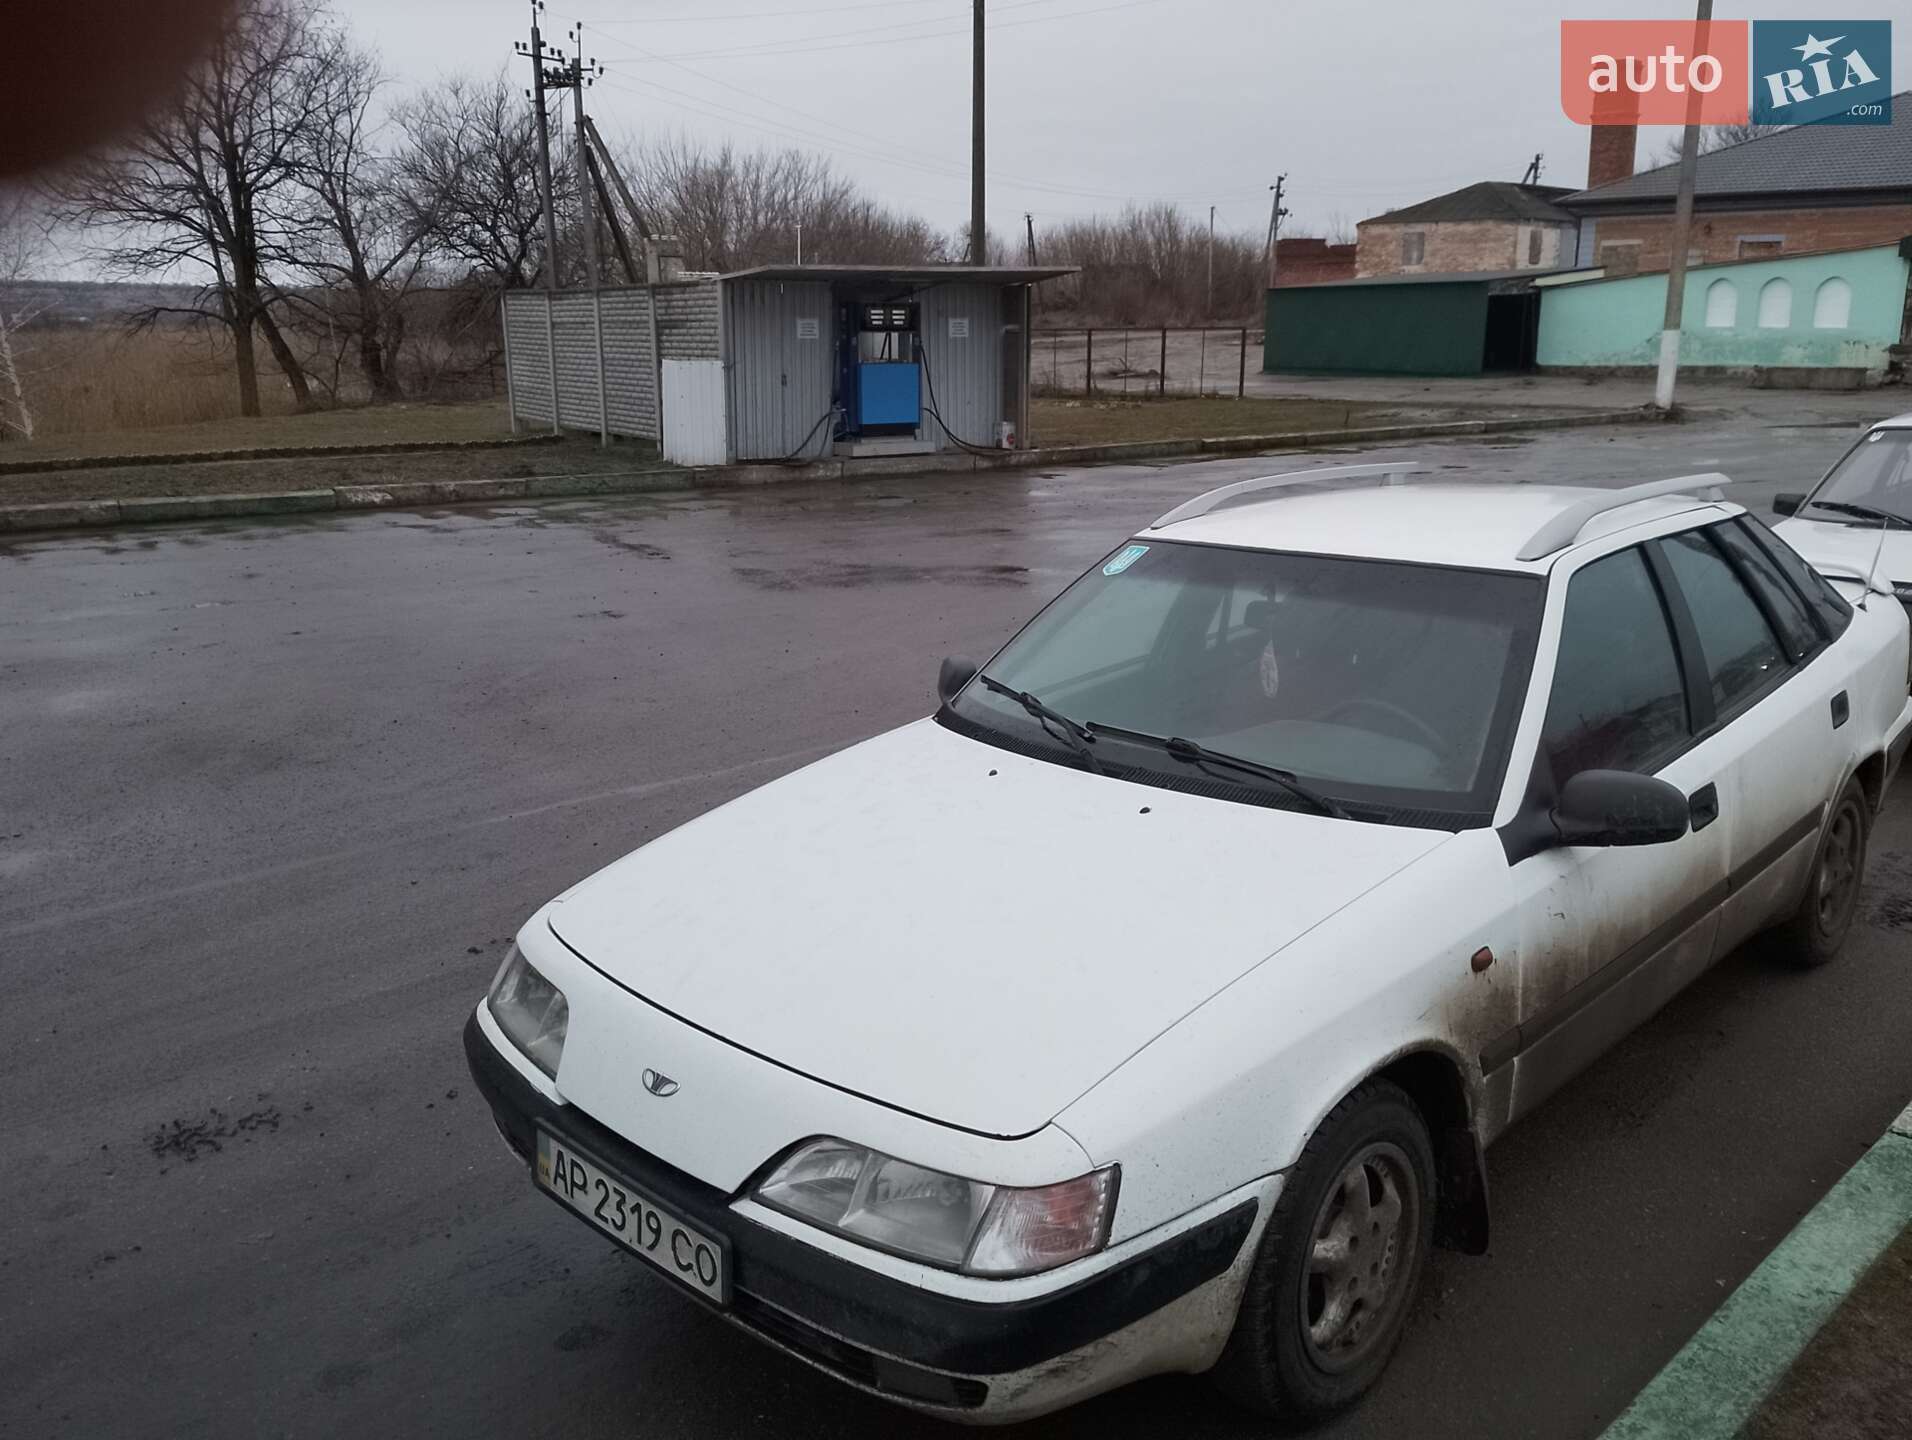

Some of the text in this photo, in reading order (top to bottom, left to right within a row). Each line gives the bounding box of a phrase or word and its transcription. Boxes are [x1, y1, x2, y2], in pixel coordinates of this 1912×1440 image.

[554, 1149, 718, 1288] AP 2319 CO
